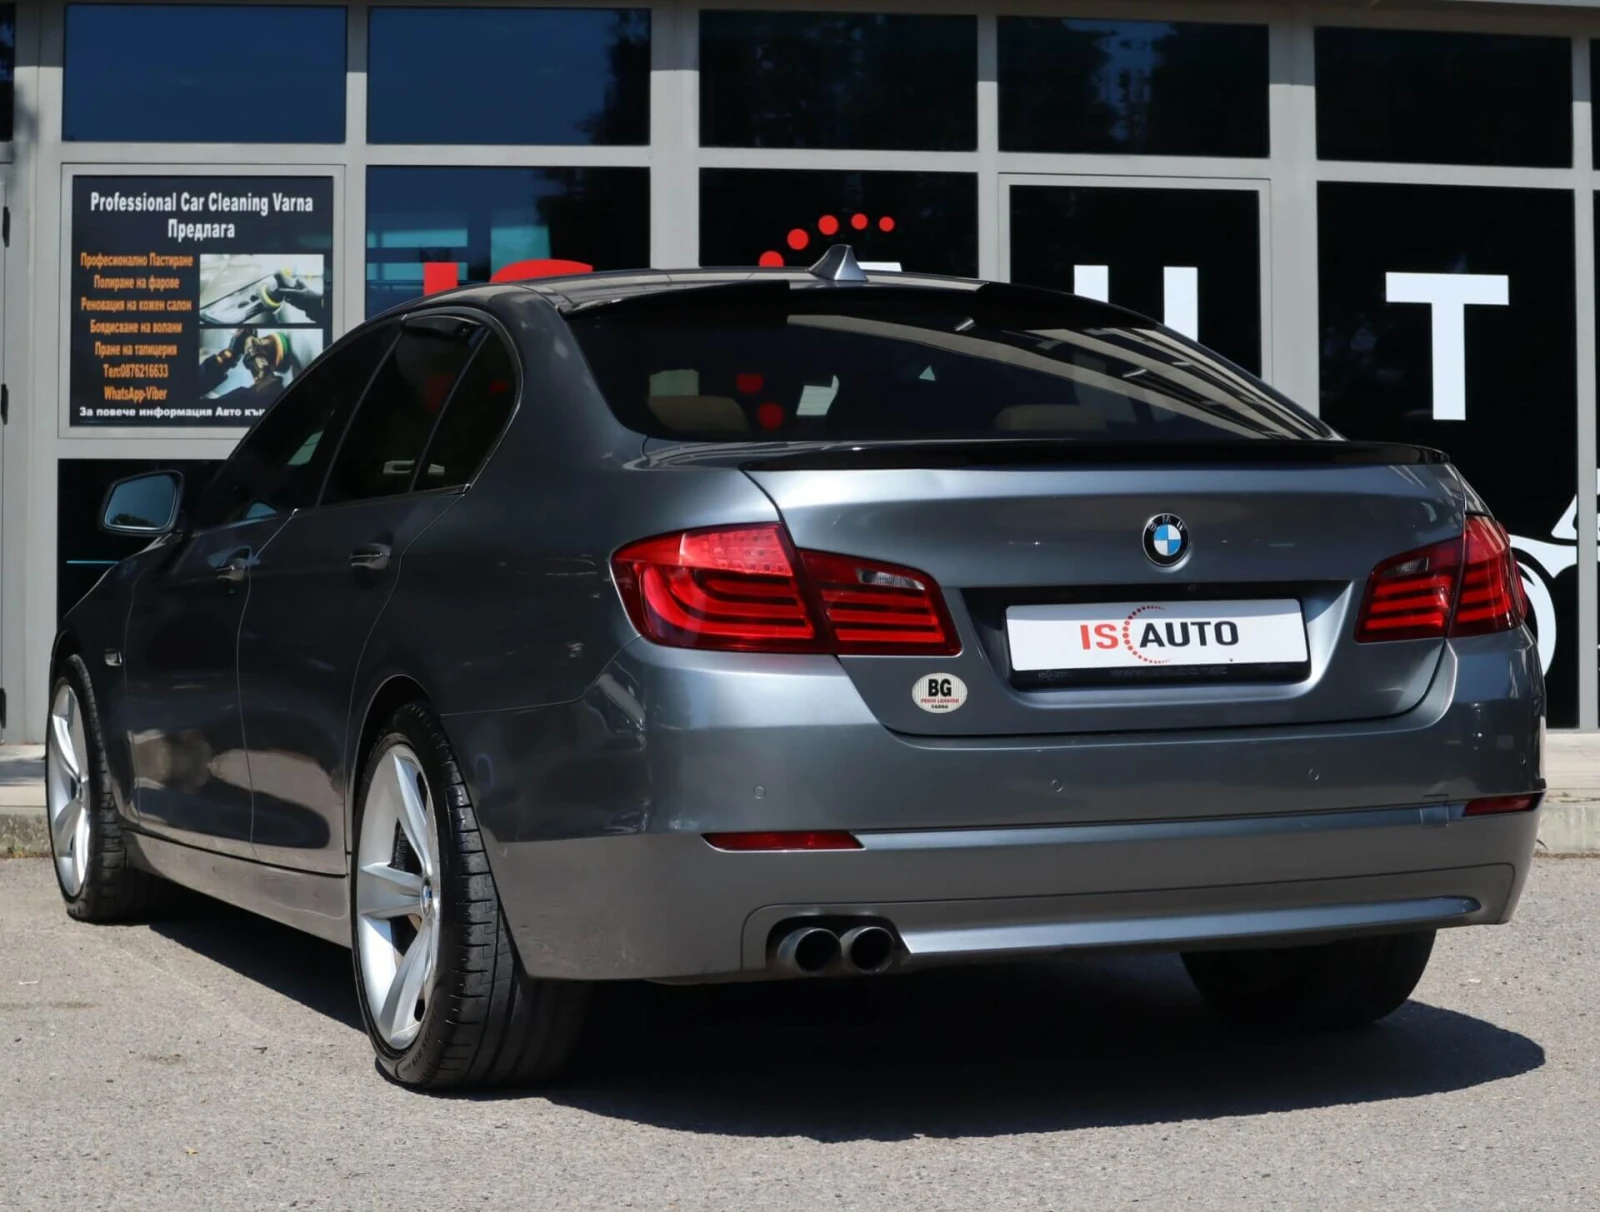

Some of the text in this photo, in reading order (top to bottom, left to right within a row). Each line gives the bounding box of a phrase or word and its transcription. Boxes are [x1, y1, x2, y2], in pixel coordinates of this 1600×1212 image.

[90, 192, 313, 216] Professional Car Cleaning Varna
[168, 218, 235, 242] Предлага
[80, 252, 194, 270] Професионално Пастиране
[94, 274, 180, 292] Полиране на фарове
[81, 297, 192, 313] Реновация на кожен салон
[140, 322, 152, 333] на
[153, 322, 183, 333] волани
[95, 341, 178, 358] Пране на тапицерия
[104, 386, 168, 403] WhatsApp-Viber
[79, 406, 93, 417] За
[96, 408, 136, 417] повече
[139, 406, 212, 419] информация
[215, 406, 241, 417] Авто
[1080, 621, 1239, 650] IS AUTO
[928, 678, 952, 697] BG
